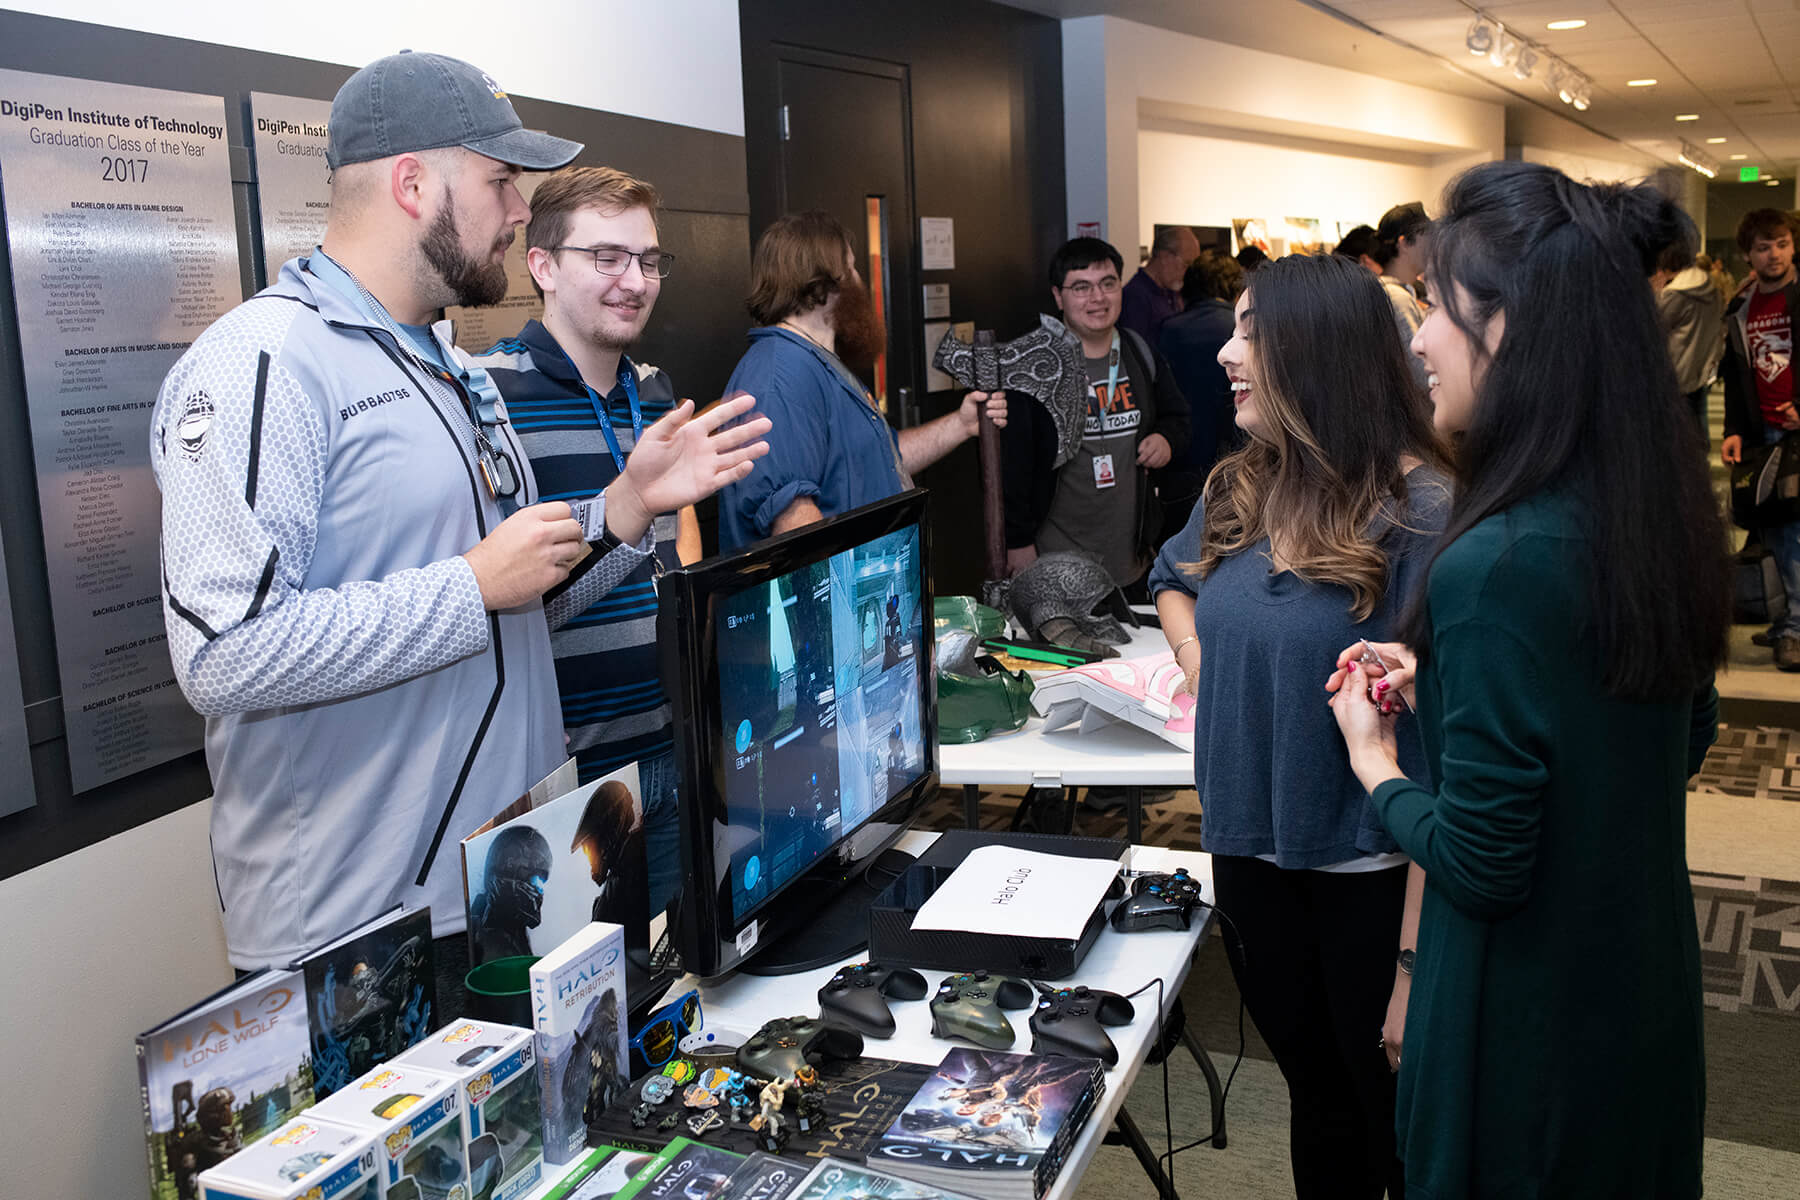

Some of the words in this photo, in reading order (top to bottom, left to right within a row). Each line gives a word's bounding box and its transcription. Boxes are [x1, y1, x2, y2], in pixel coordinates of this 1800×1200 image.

[1, 100, 64, 121] DigiPen
[68, 108, 130, 128] Institute
[134, 116, 150, 128] of
[152, 117, 223, 139] Technology
[258, 118, 300, 135] DigiPen
[304, 124, 329, 138] Insti
[30, 128, 104, 148] Graduation
[107, 134, 142, 152] Class
[145, 138, 156, 152] of
[161, 140, 179, 154] the
[182, 142, 206, 157] Year
[100, 156, 149, 183] 2017
[71, 202, 105, 210] BACHELOR
[65, 348, 100, 356] BACHELOR
[110, 346, 127, 354] ARTS
[61, 408, 96, 417] BACHELOR
[1107, 412, 1140, 428] TODAY
[92, 604, 126, 617] BACHELOR
[126, 601, 136, 610] OF
[104, 641, 138, 656] BACHELOR
[138, 638, 147, 648] OF
[83, 697, 117, 712] BACHELOR
[118, 694, 126, 704] OF
[128, 685, 153, 700] SCIENCE
[154, 683, 161, 691] IN
[992, 886, 1018, 905] Halo
[1006, 867, 1032, 884] Club
[558, 948, 620, 1000] HALO
[565, 968, 615, 1008] RETRIBUTION
[164, 988, 295, 1062] HALO
[536, 978, 551, 1051] HALO
[184, 1038, 228, 1068] LONE
[234, 1016, 280, 1043] WOLF
[521, 1047, 532, 1064] 09
[444, 1094, 456, 1112] 07
[806, 1082, 880, 1158] HALO
[568, 1126, 584, 1144] TROY
[611, 1140, 649, 1152] HALO
[361, 1152, 373, 1172] 10
[879, 1144, 1028, 1167] HALO
[652, 1160, 693, 1196] HALO
